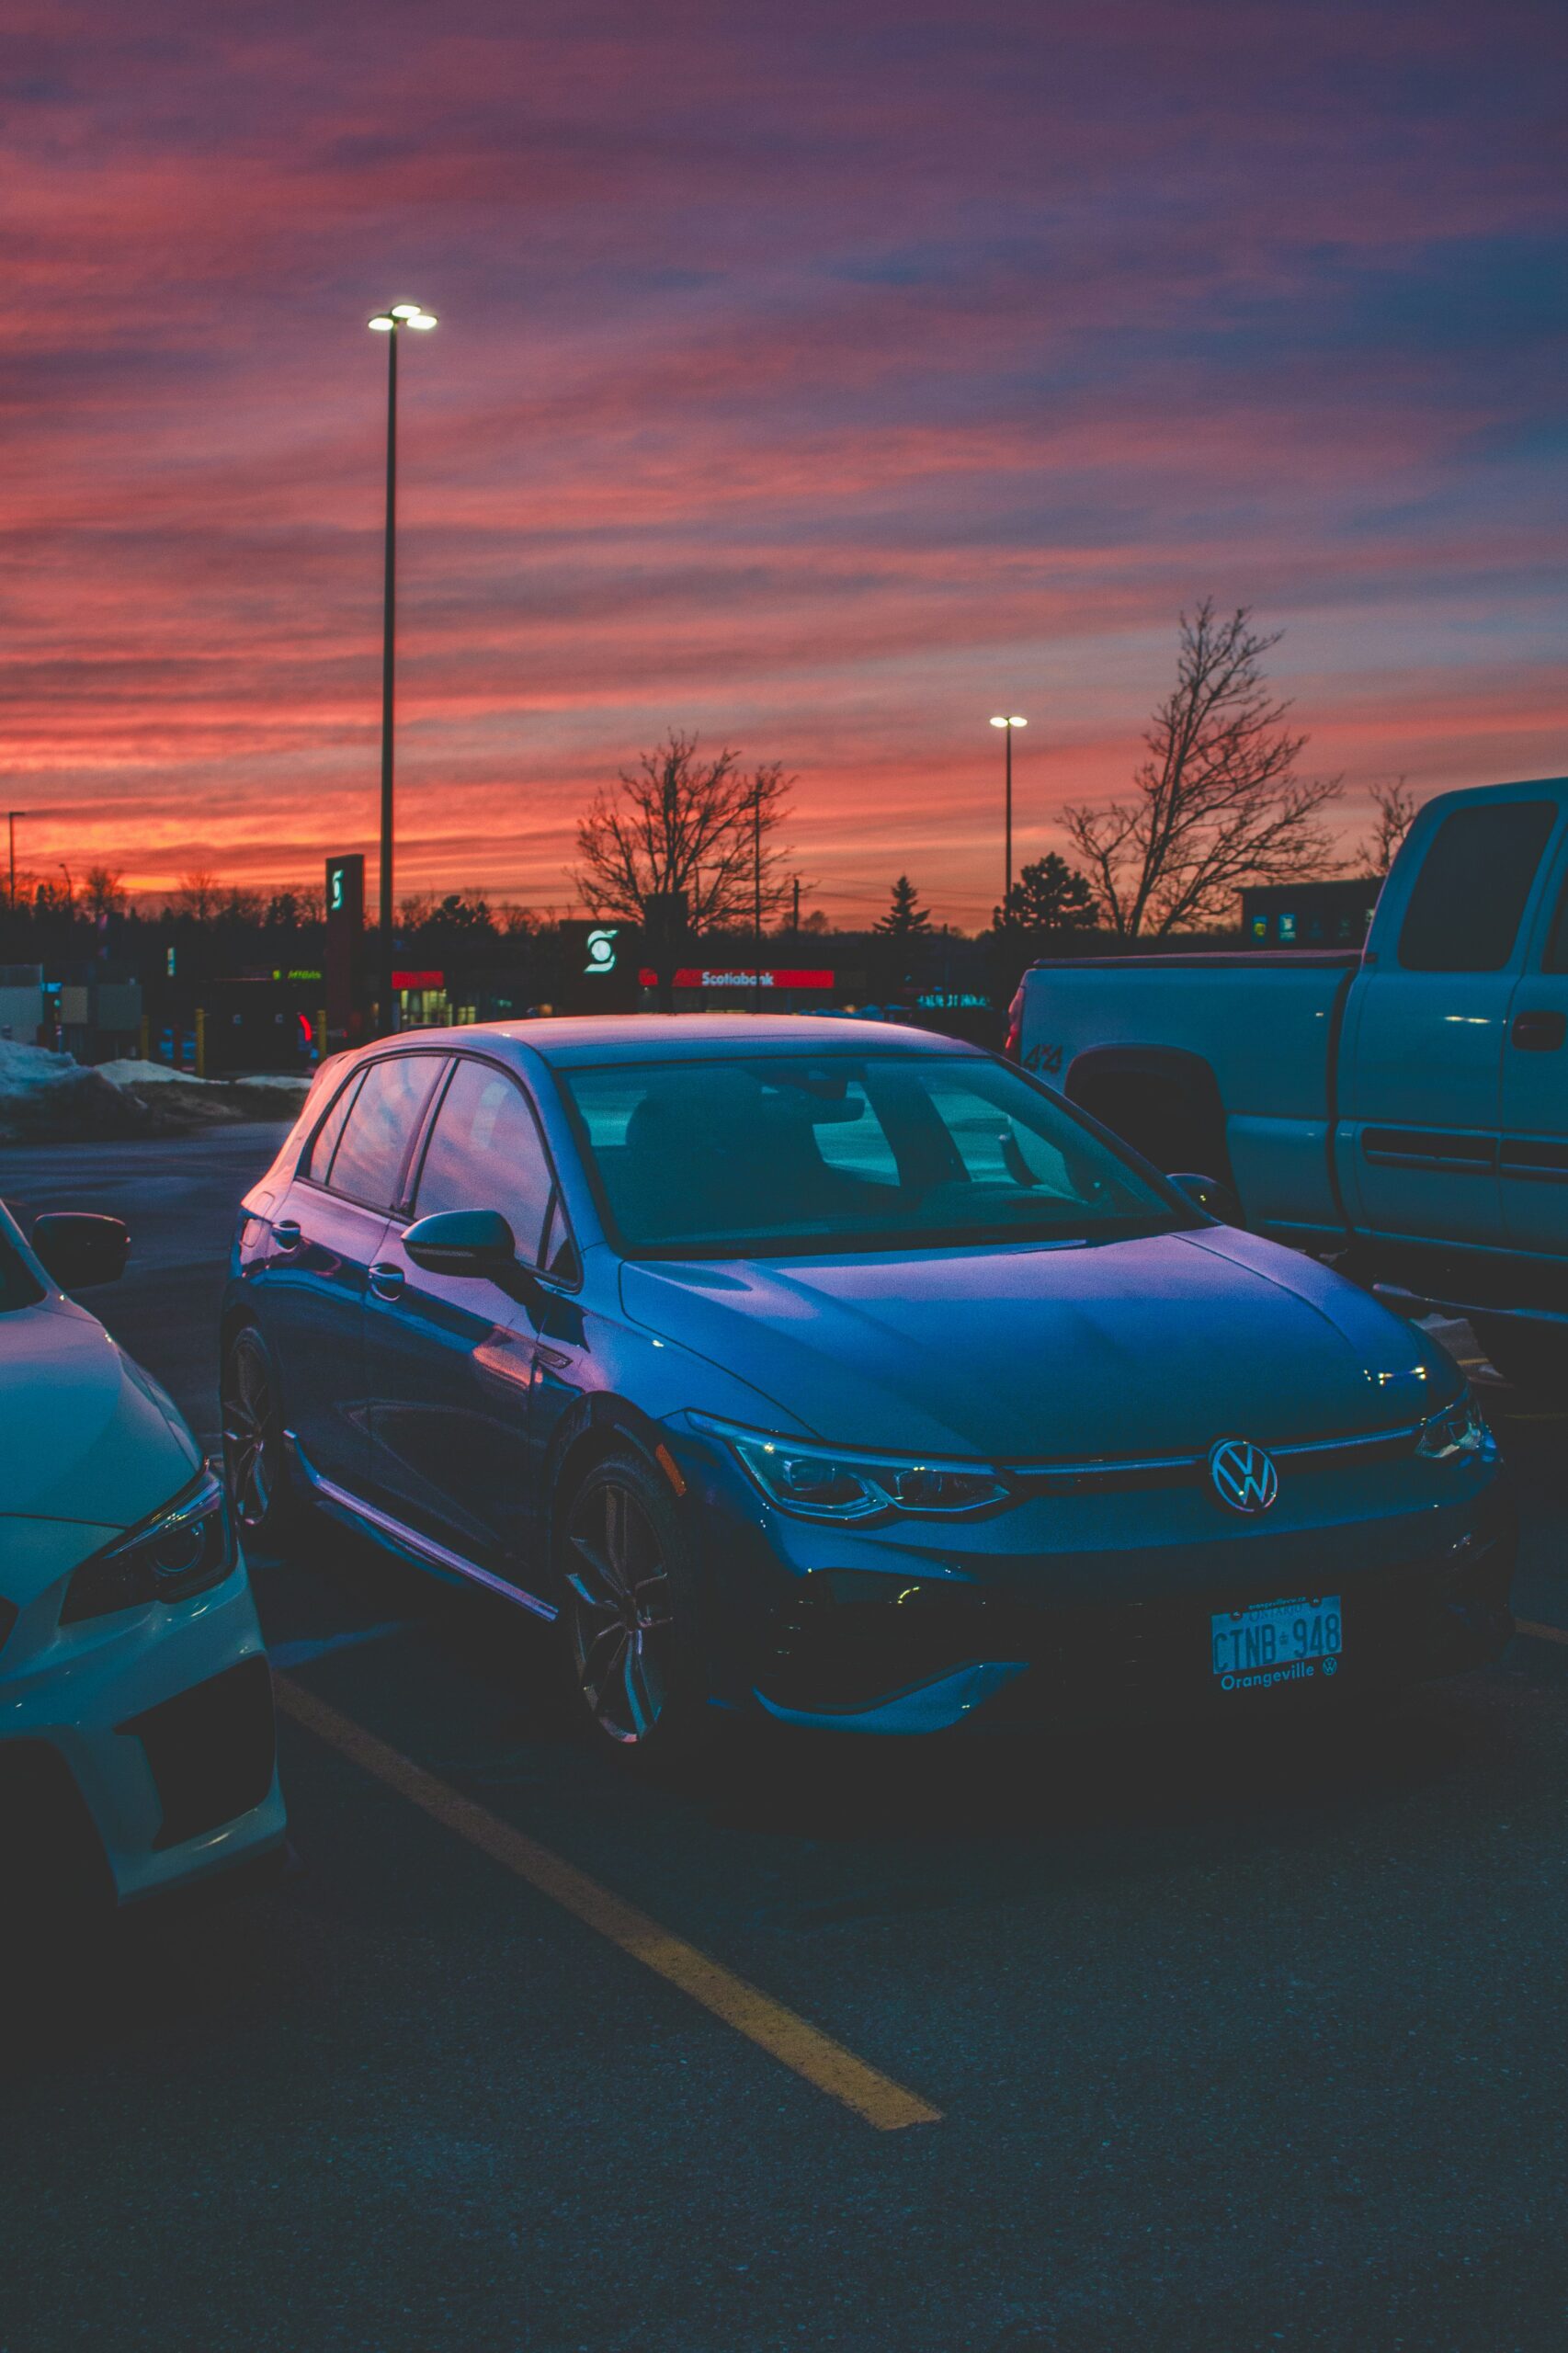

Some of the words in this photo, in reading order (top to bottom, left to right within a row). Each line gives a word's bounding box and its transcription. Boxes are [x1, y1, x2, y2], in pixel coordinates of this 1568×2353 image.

[701, 972, 774, 986] Scotiabank
[1214, 1624, 1276, 1672] CTNB
[1292, 1613, 1340, 1658] 948
[1221, 1662, 1314, 1690] Orangeville
